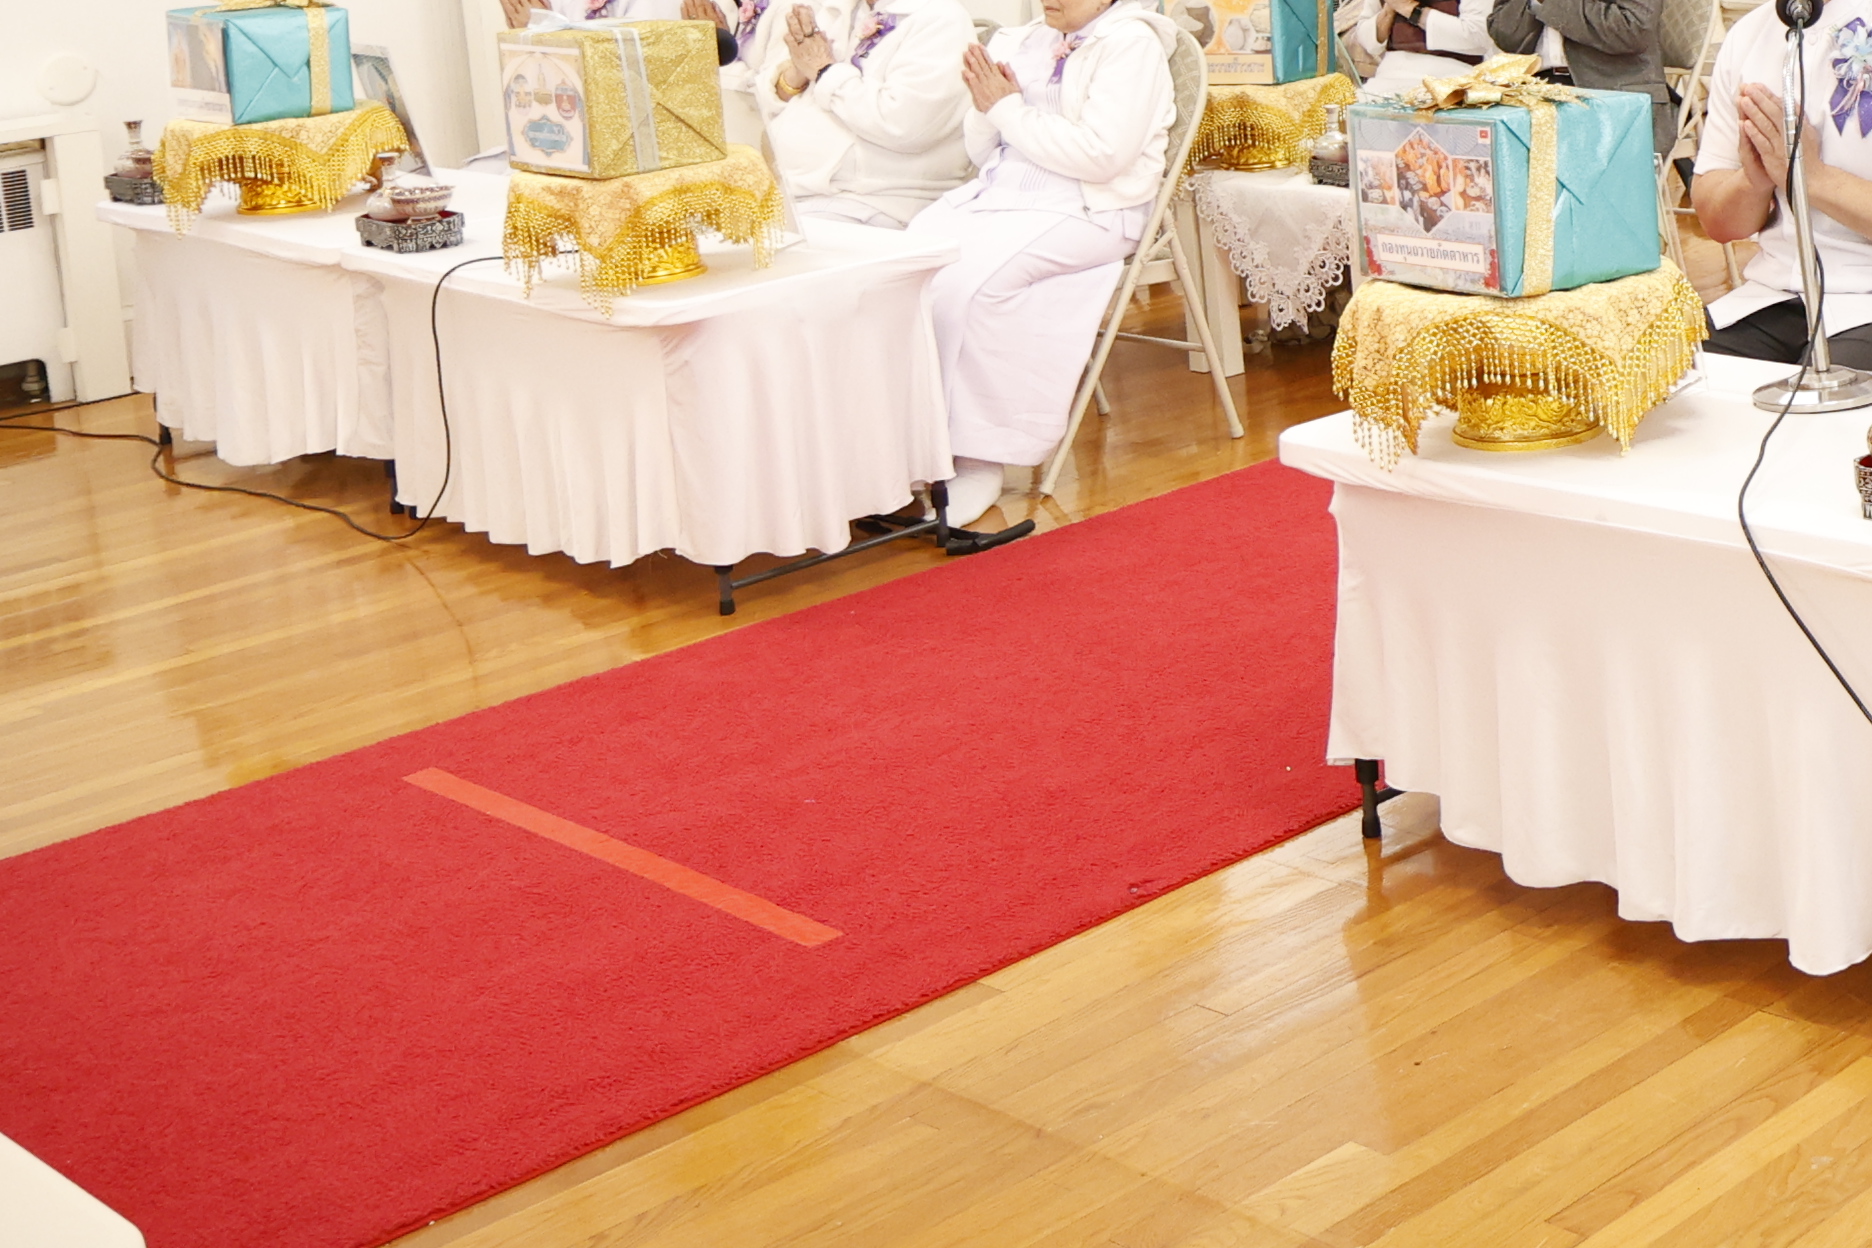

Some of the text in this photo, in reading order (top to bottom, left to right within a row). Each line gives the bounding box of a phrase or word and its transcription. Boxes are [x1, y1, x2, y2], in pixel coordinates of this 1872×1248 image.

[1381, 241, 1480, 265] กองทุนถวายภัตตาหาร
